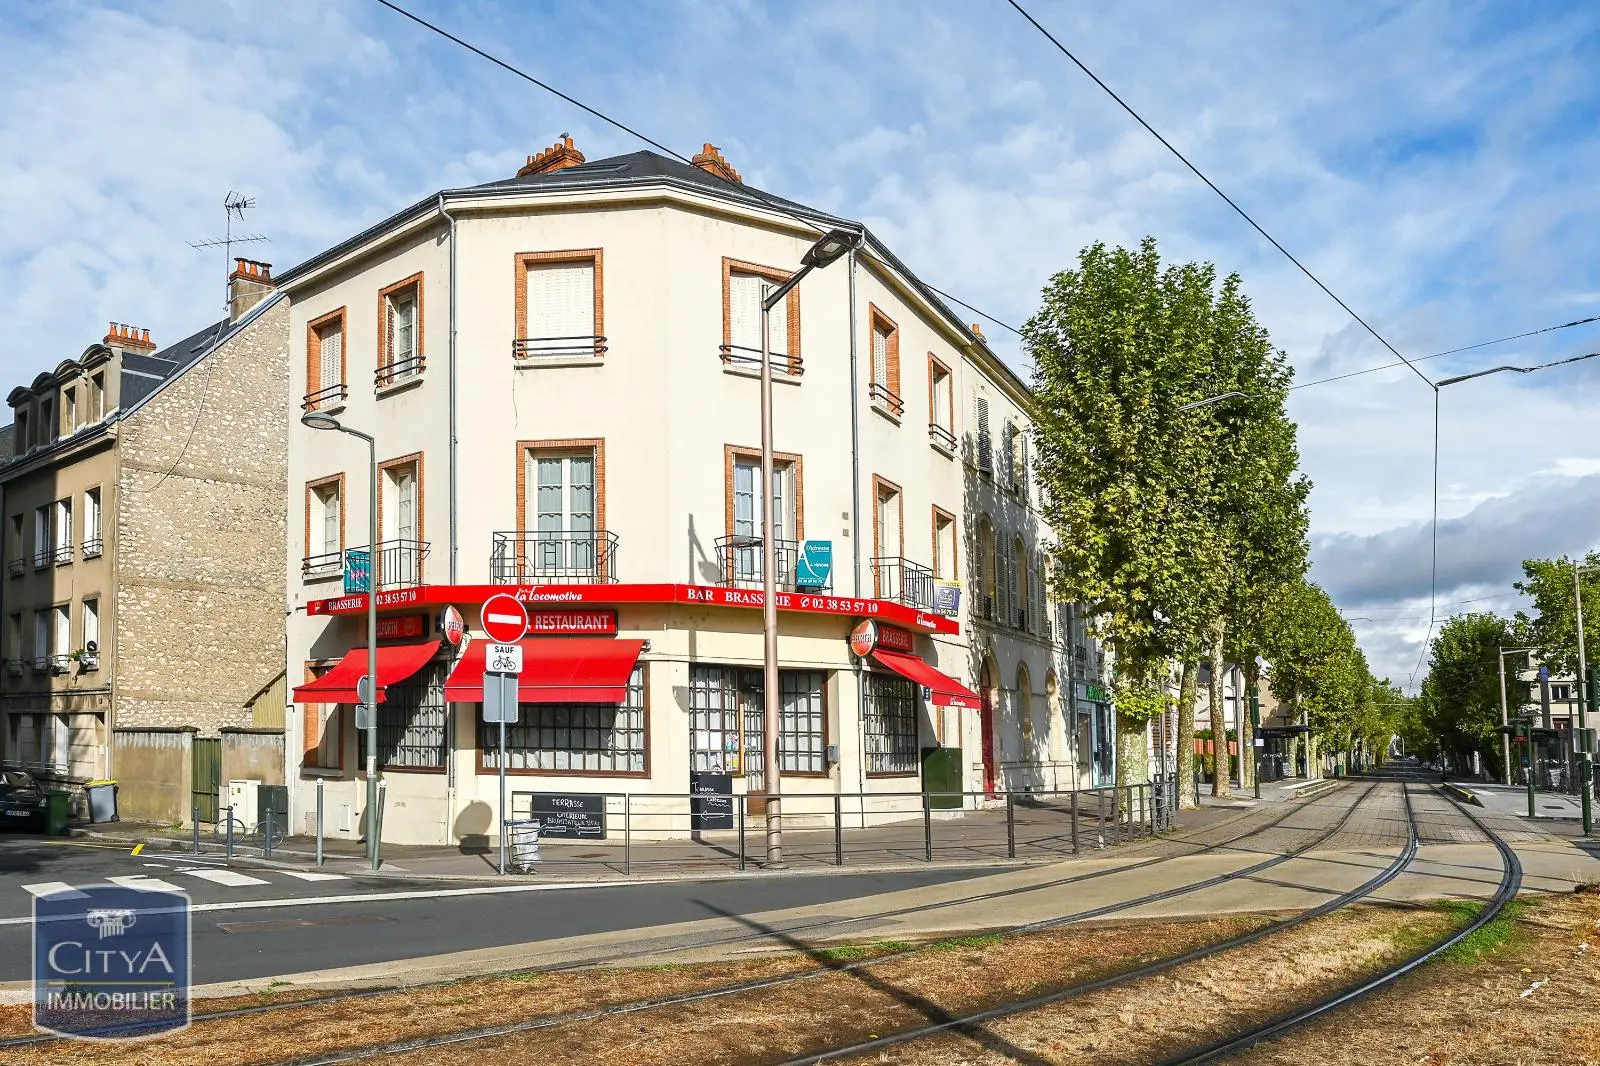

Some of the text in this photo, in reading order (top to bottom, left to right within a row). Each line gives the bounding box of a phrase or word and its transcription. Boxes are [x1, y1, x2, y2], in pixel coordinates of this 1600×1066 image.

[328, 598, 363, 611] BRASSERIE
[384, 593, 391, 604] 38
[392, 592, 400, 603] 53
[400, 591, 408, 602] 57
[409, 590, 417, 601] 10
[687, 588, 878, 613] BAR BRASSIE 02 38 53 57 10
[376, 621, 398, 636] ELFORTH
[535, 615, 609, 630] RESTAURANT
[494, 645, 515, 654] SAUF
[551, 798, 584, 808] TERRASSE
